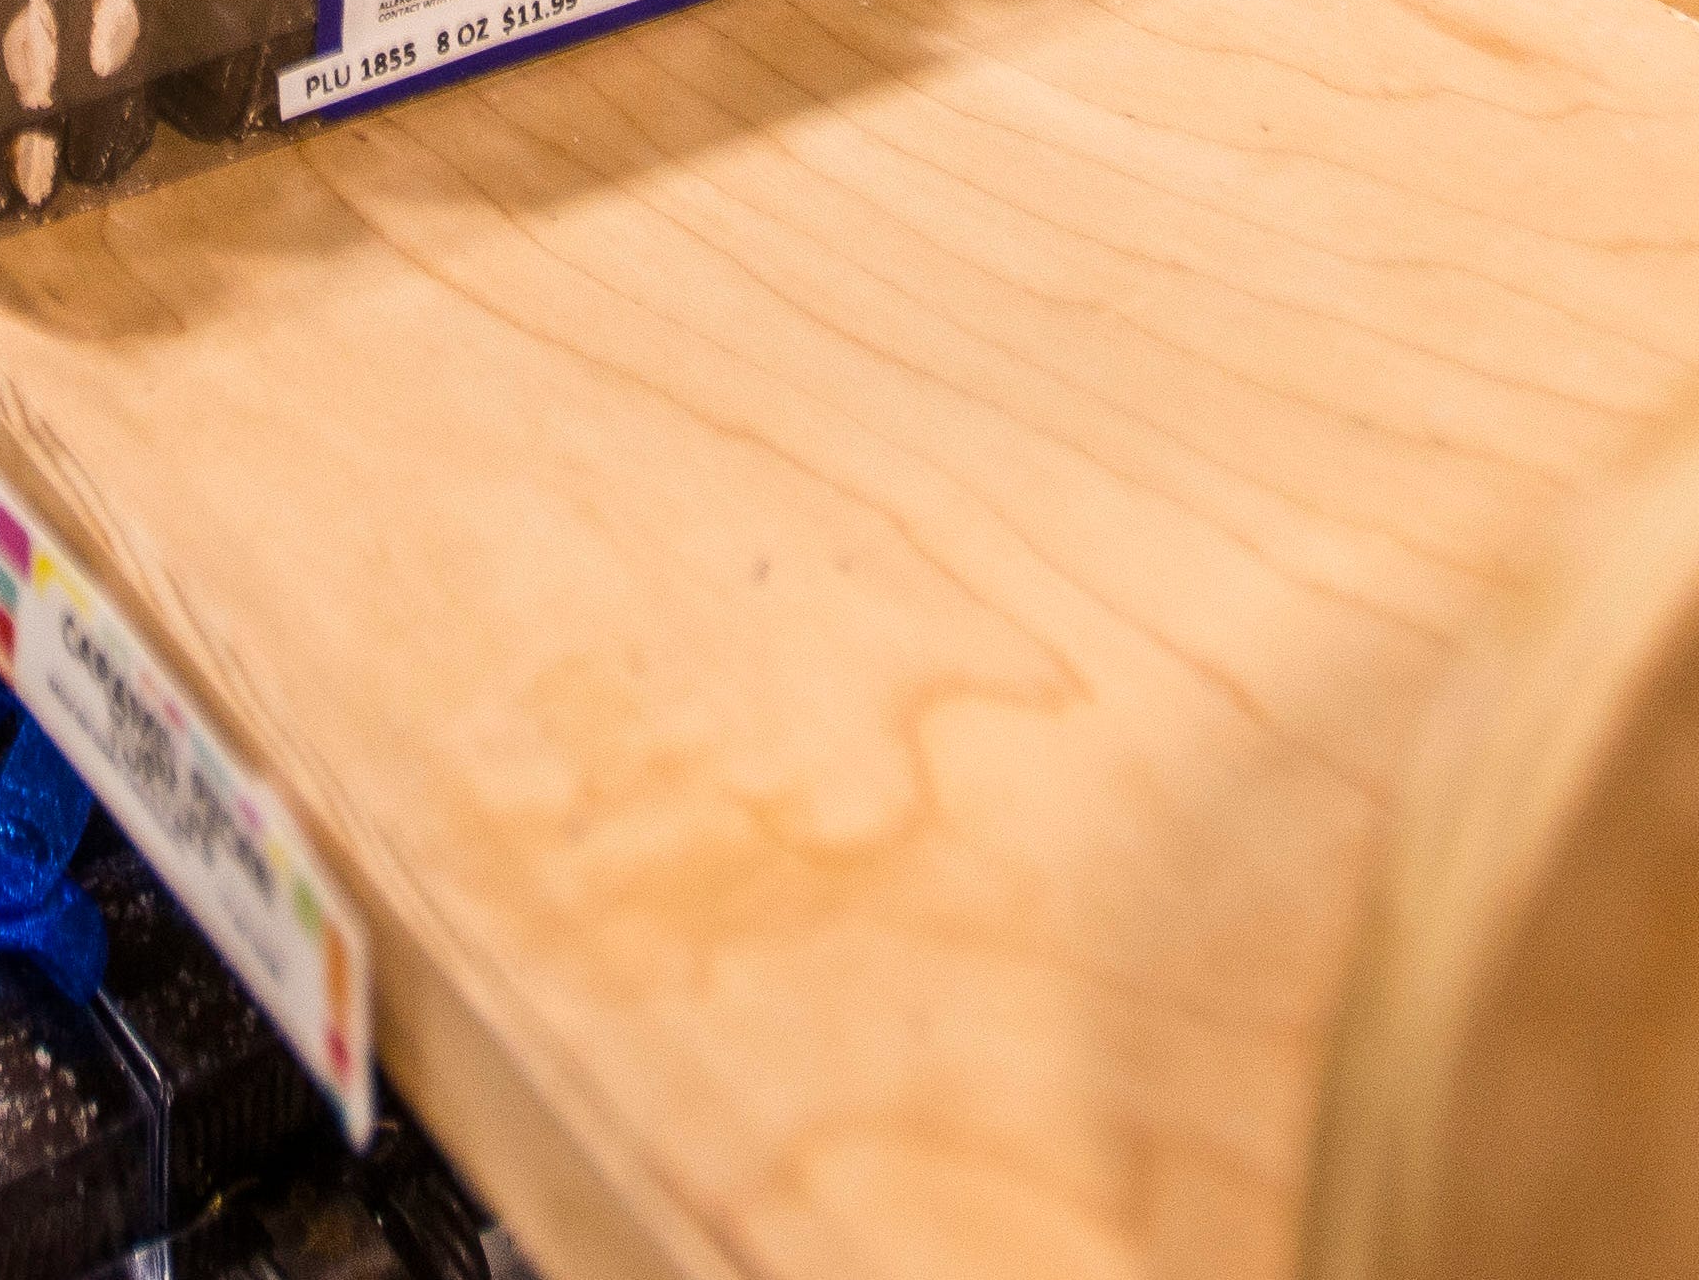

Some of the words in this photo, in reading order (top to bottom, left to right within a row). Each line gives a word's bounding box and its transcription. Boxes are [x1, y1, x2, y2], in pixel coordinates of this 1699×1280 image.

[306, 62, 350, 101] PLU
[360, 40, 417, 82] 1855
[436, 29, 450, 56] 8
[457, 16, 489, 50] OZ
